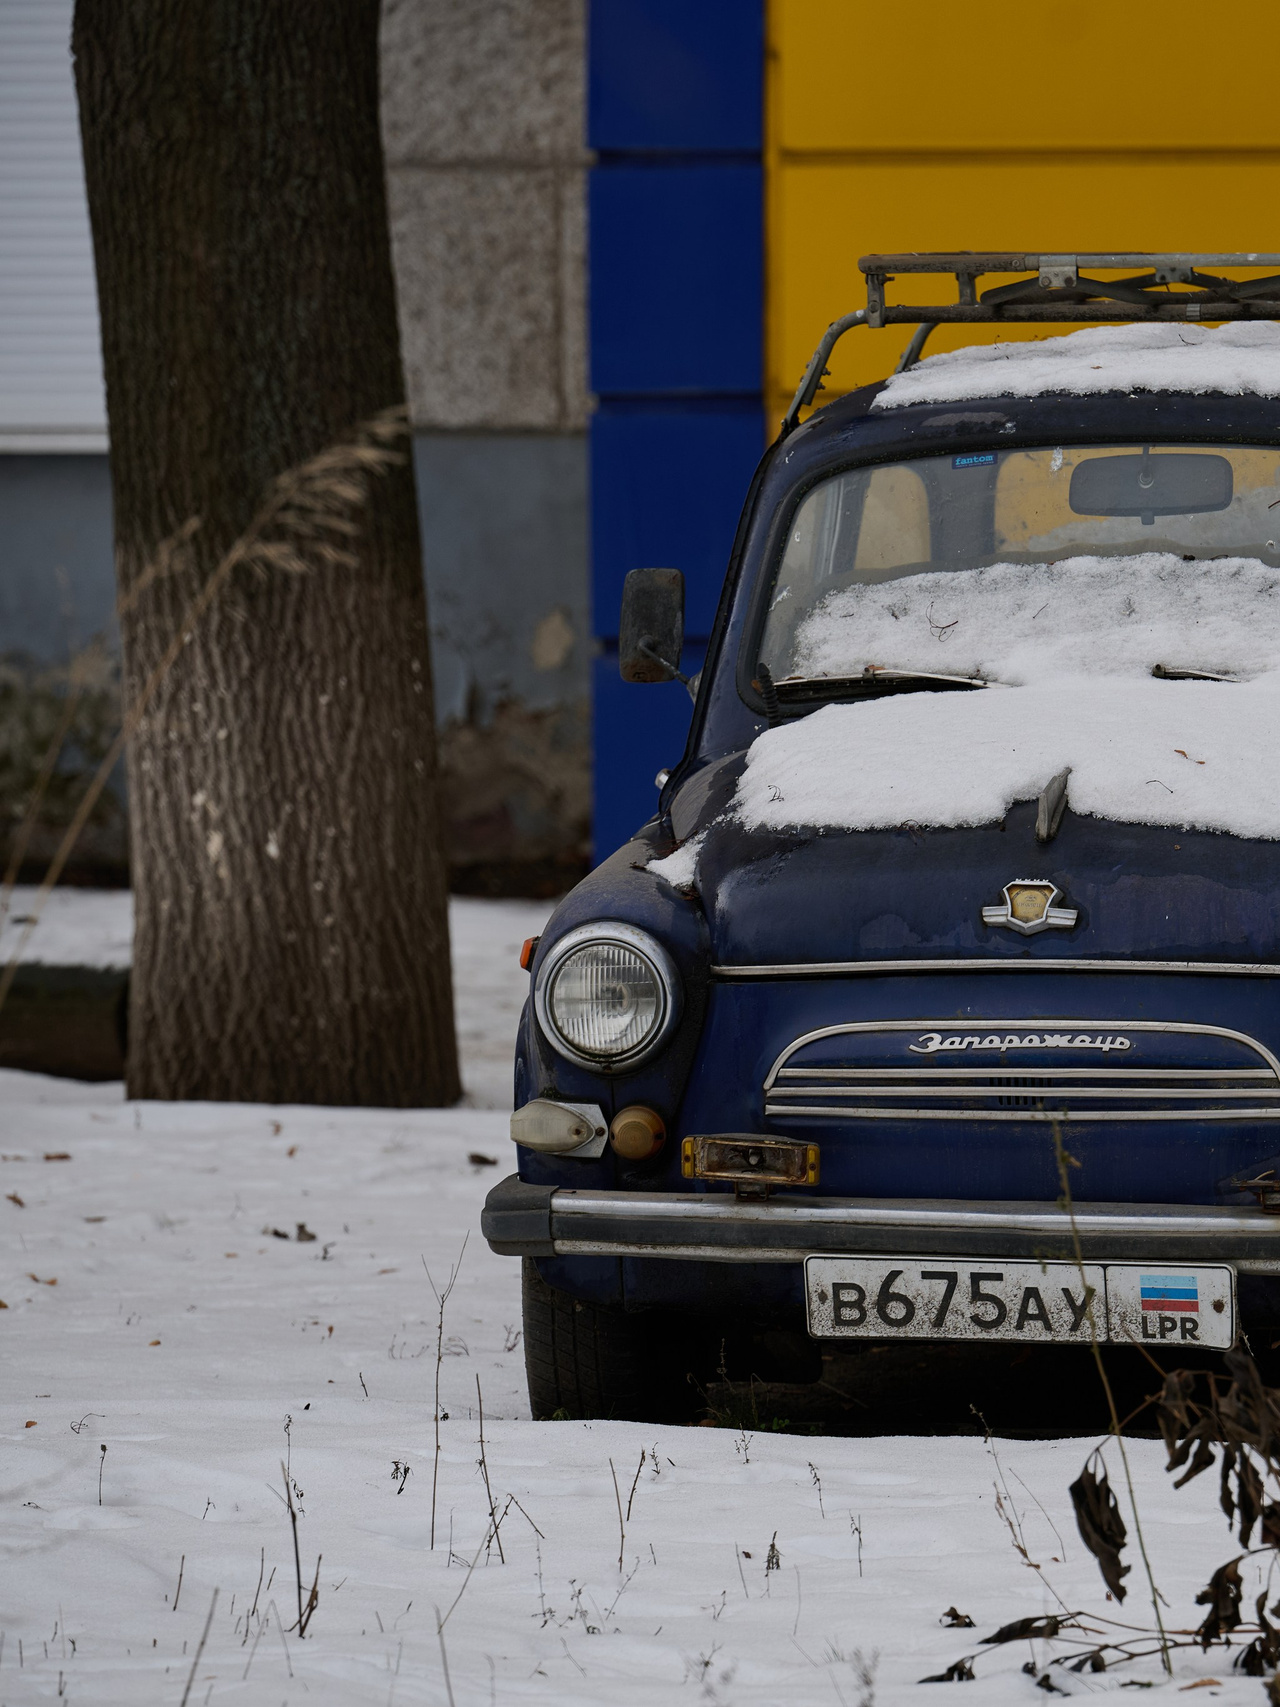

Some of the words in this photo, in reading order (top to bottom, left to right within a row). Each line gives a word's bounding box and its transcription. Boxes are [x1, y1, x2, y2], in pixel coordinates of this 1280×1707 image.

[955, 454, 994, 465] fantom
[831, 1269, 1096, 1332] В675АУ
[1141, 1315, 1200, 1341] LPR
